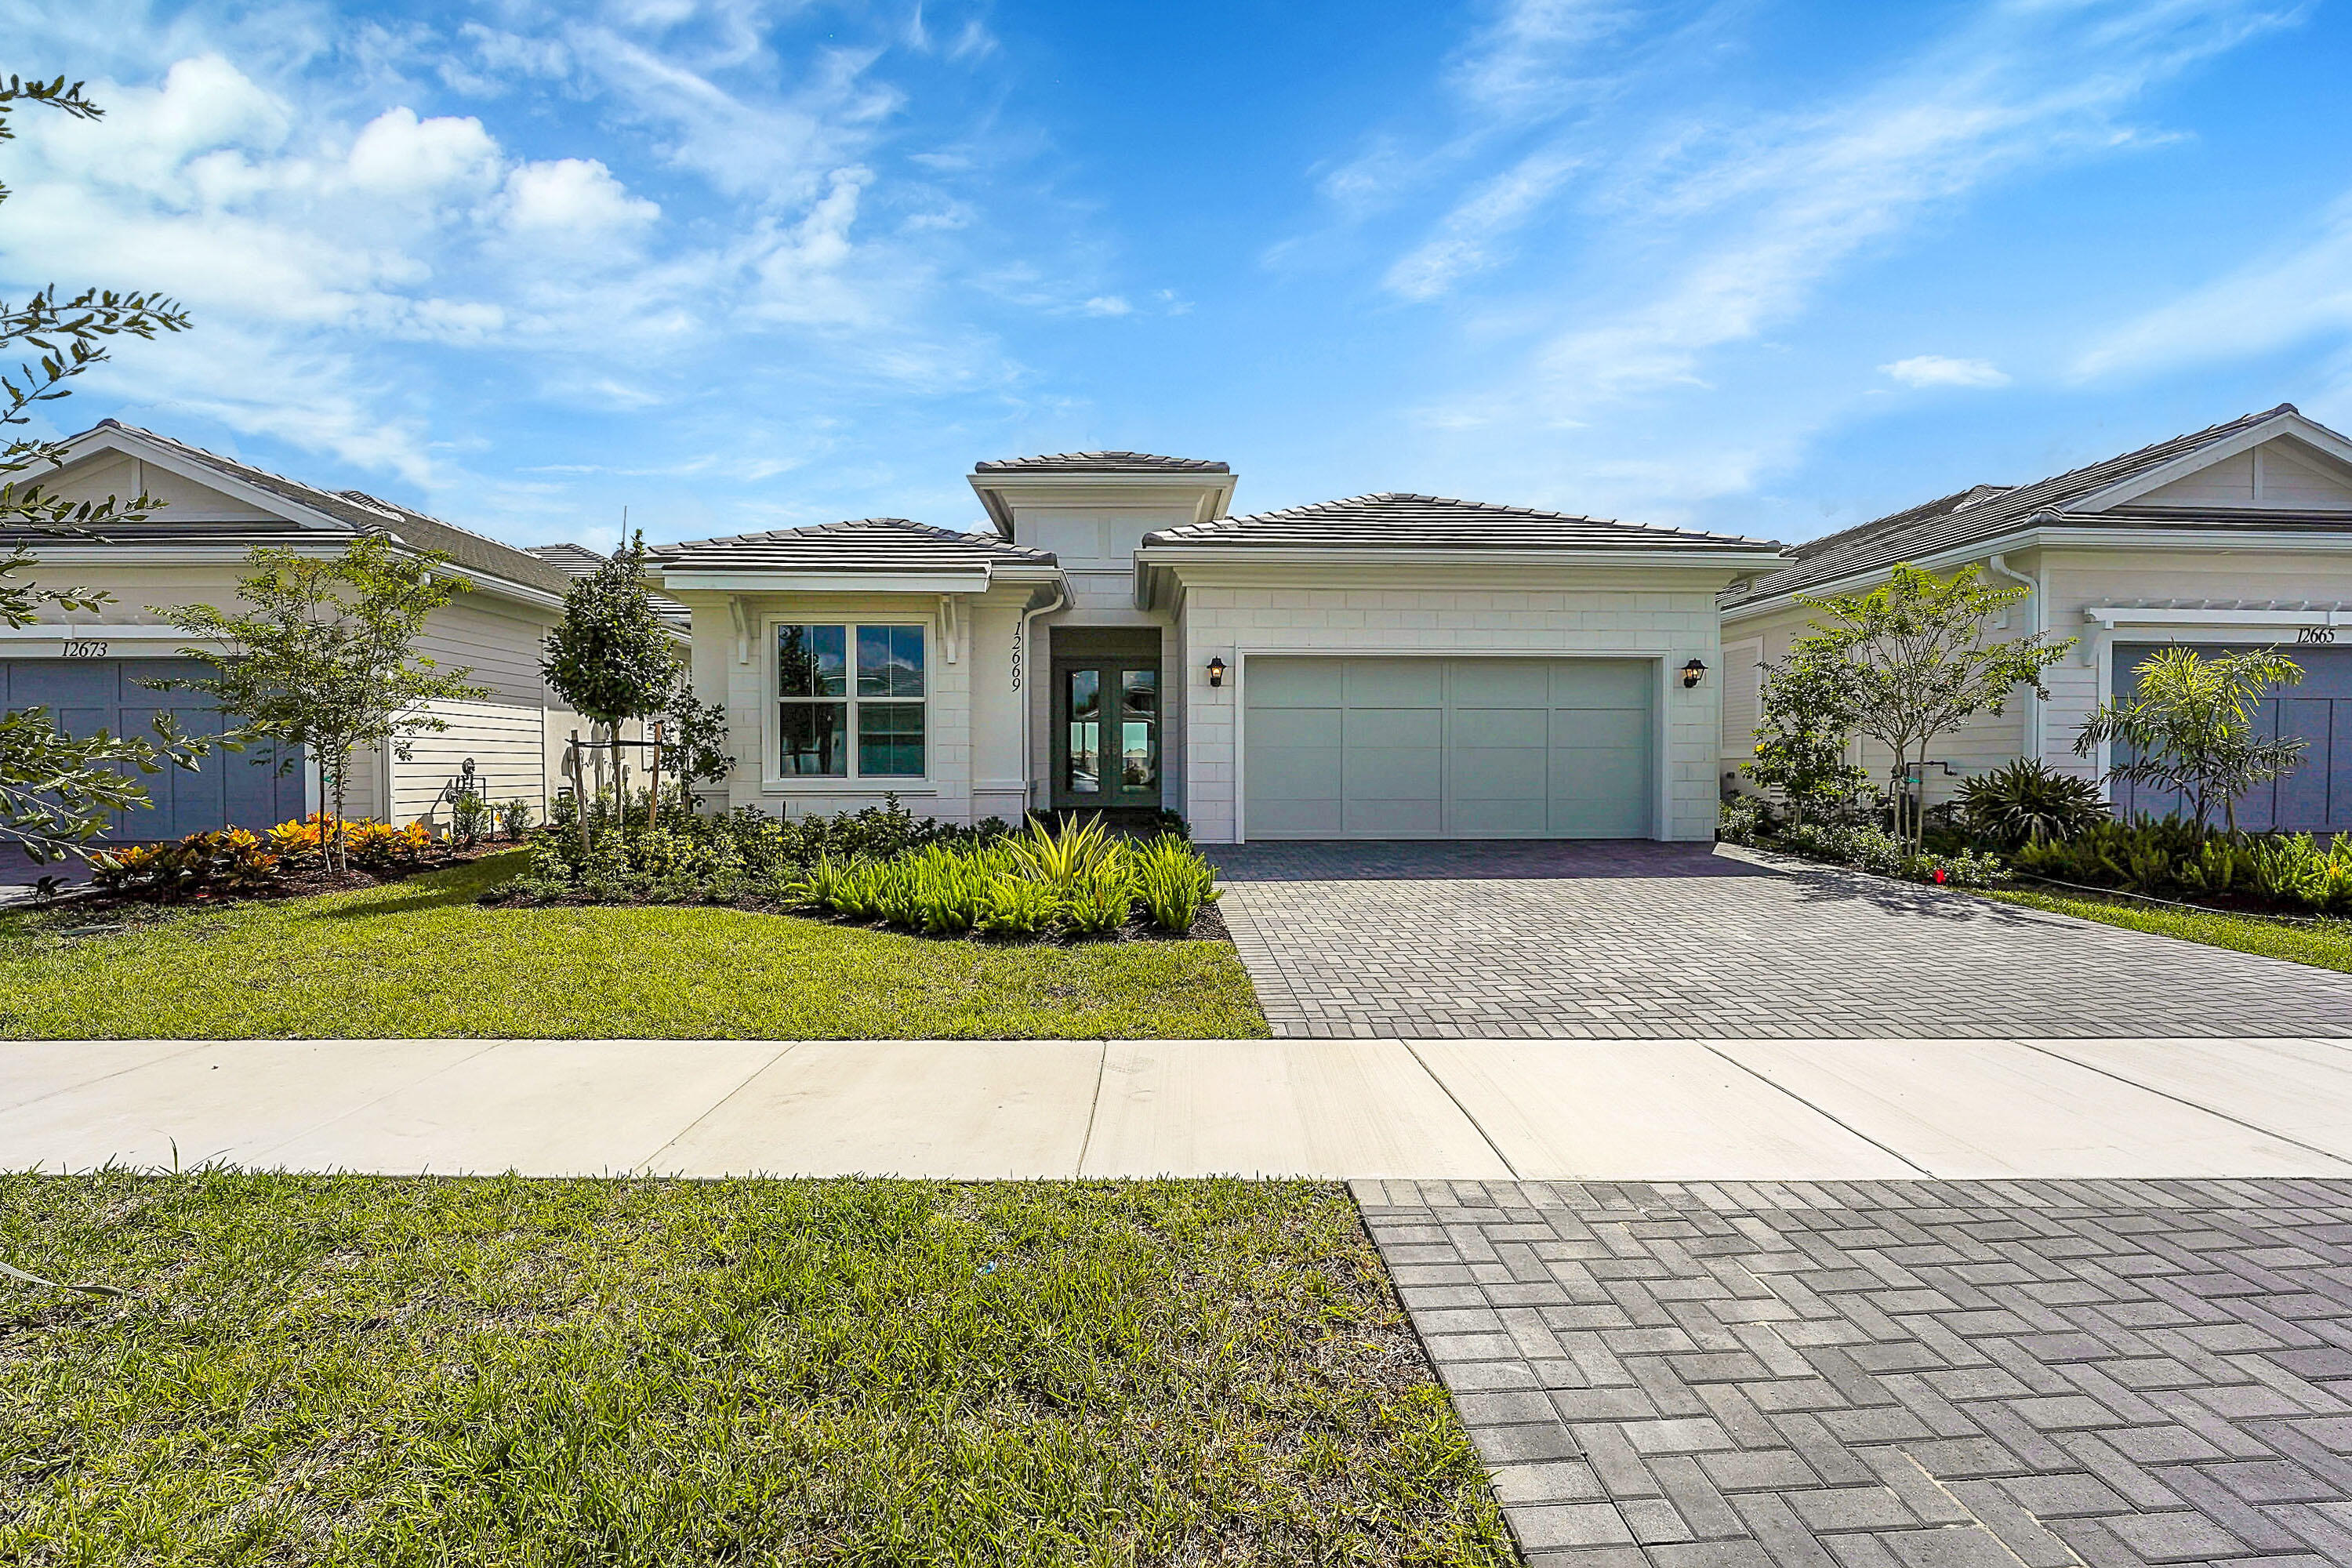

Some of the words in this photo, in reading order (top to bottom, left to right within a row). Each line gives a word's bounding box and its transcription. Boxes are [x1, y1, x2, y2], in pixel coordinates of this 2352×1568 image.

[2296, 626, 2336, 643] 12665
[63, 641, 107, 657] 12673
[1012, 621, 1021, 692] 12669
